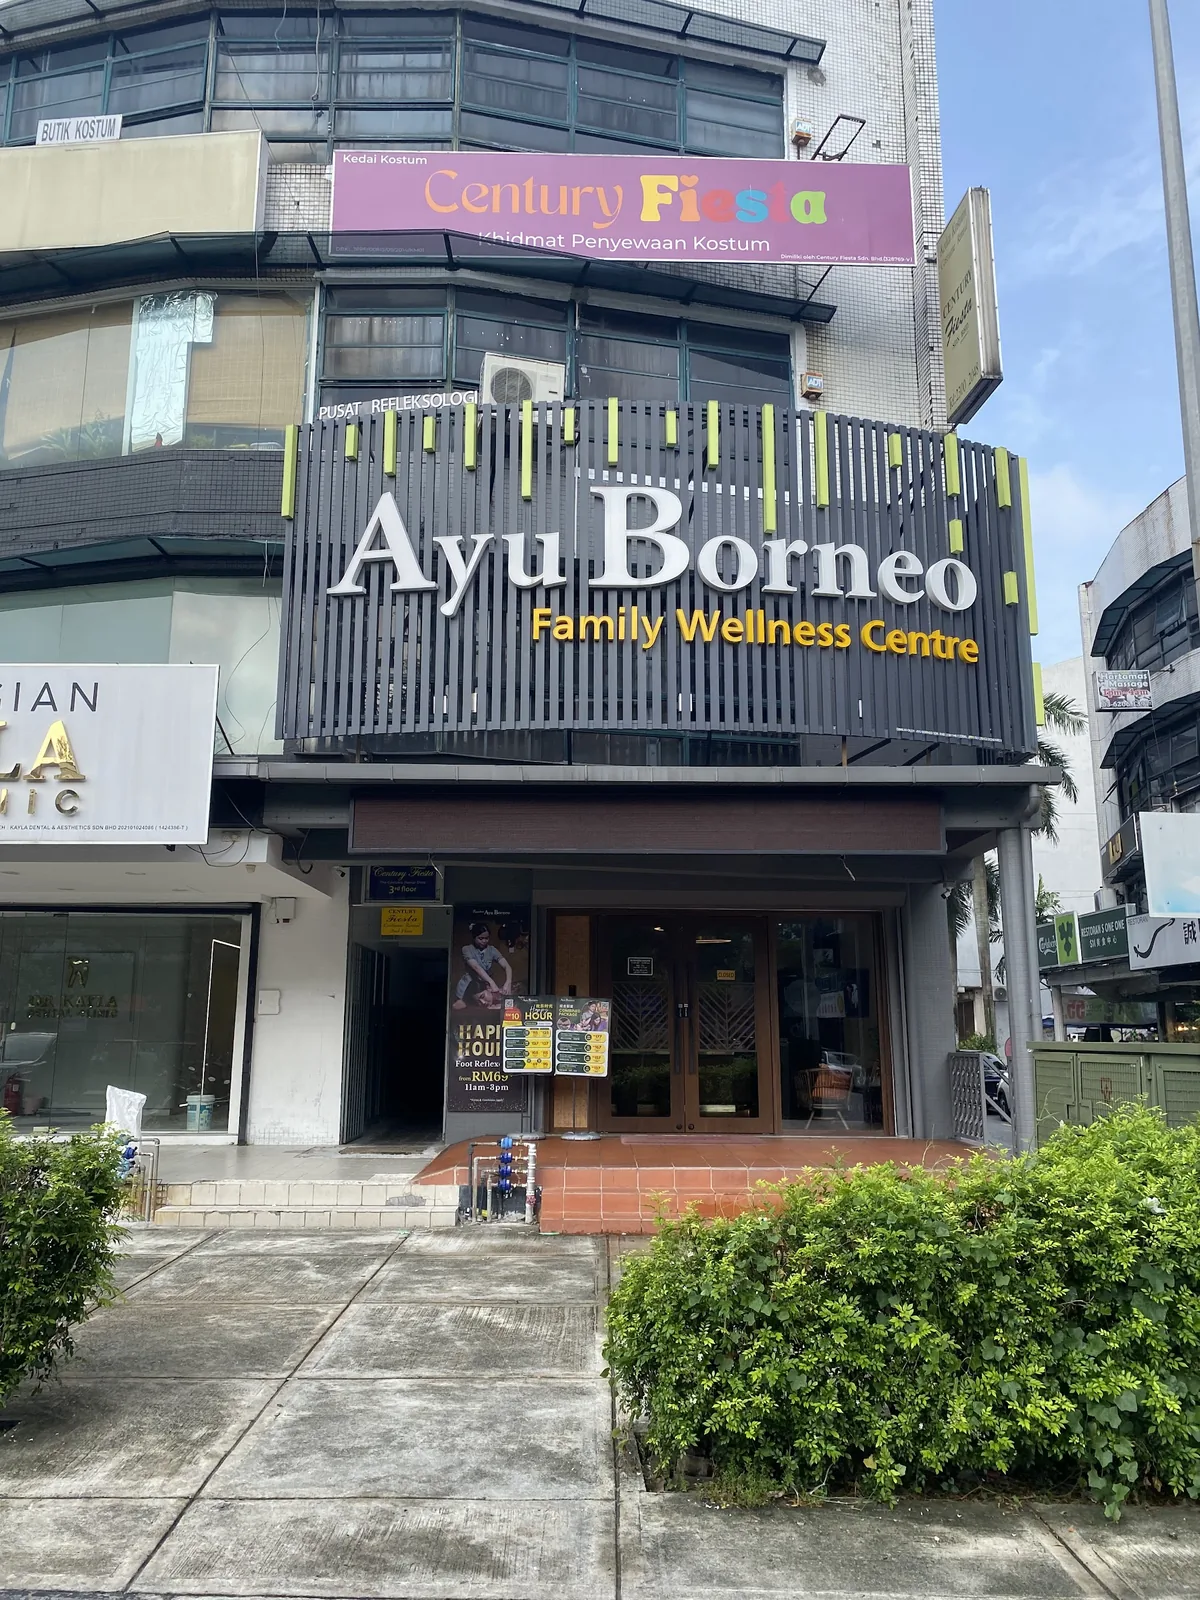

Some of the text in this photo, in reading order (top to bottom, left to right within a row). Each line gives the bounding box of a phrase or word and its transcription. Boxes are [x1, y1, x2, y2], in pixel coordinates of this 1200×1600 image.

[41, 118, 116, 142] BUTIK KOSTUM
[343, 154, 428, 165] Kedai Kostum
[424, 169, 827, 229] Century Fiesta
[478, 231, 770, 253] Khidmat Penyewaan Kostum
[943, 270, 972, 319] CENTURY
[945, 298, 972, 347] Fiesta
[807, 376, 823, 388] ADT
[318, 390, 478, 420] PUSAT REFLEKSOLOGI
[326, 486, 978, 619] Ayu Borneo
[532, 605, 980, 664] Family Wellness Centre
[1100, 672, 1148, 680] Hartamas
[1108, 680, 1149, 688] Massage
[0, 682, 99, 712] IAN
[372, 865, 434, 881] Century Fiesta
[389, 885, 401, 895] 3rd
[386, 914, 418, 923] Fiesta
[1105, 921, 1115, 933] ONE
[1115, 919, 1126, 931] ONE
[511, 1012, 521, 1020] 10
[525, 1011, 553, 1021] HOUR
[455, 1060, 473, 1068] Foot
[465, 1083, 509, 1093] 11am-3pm
